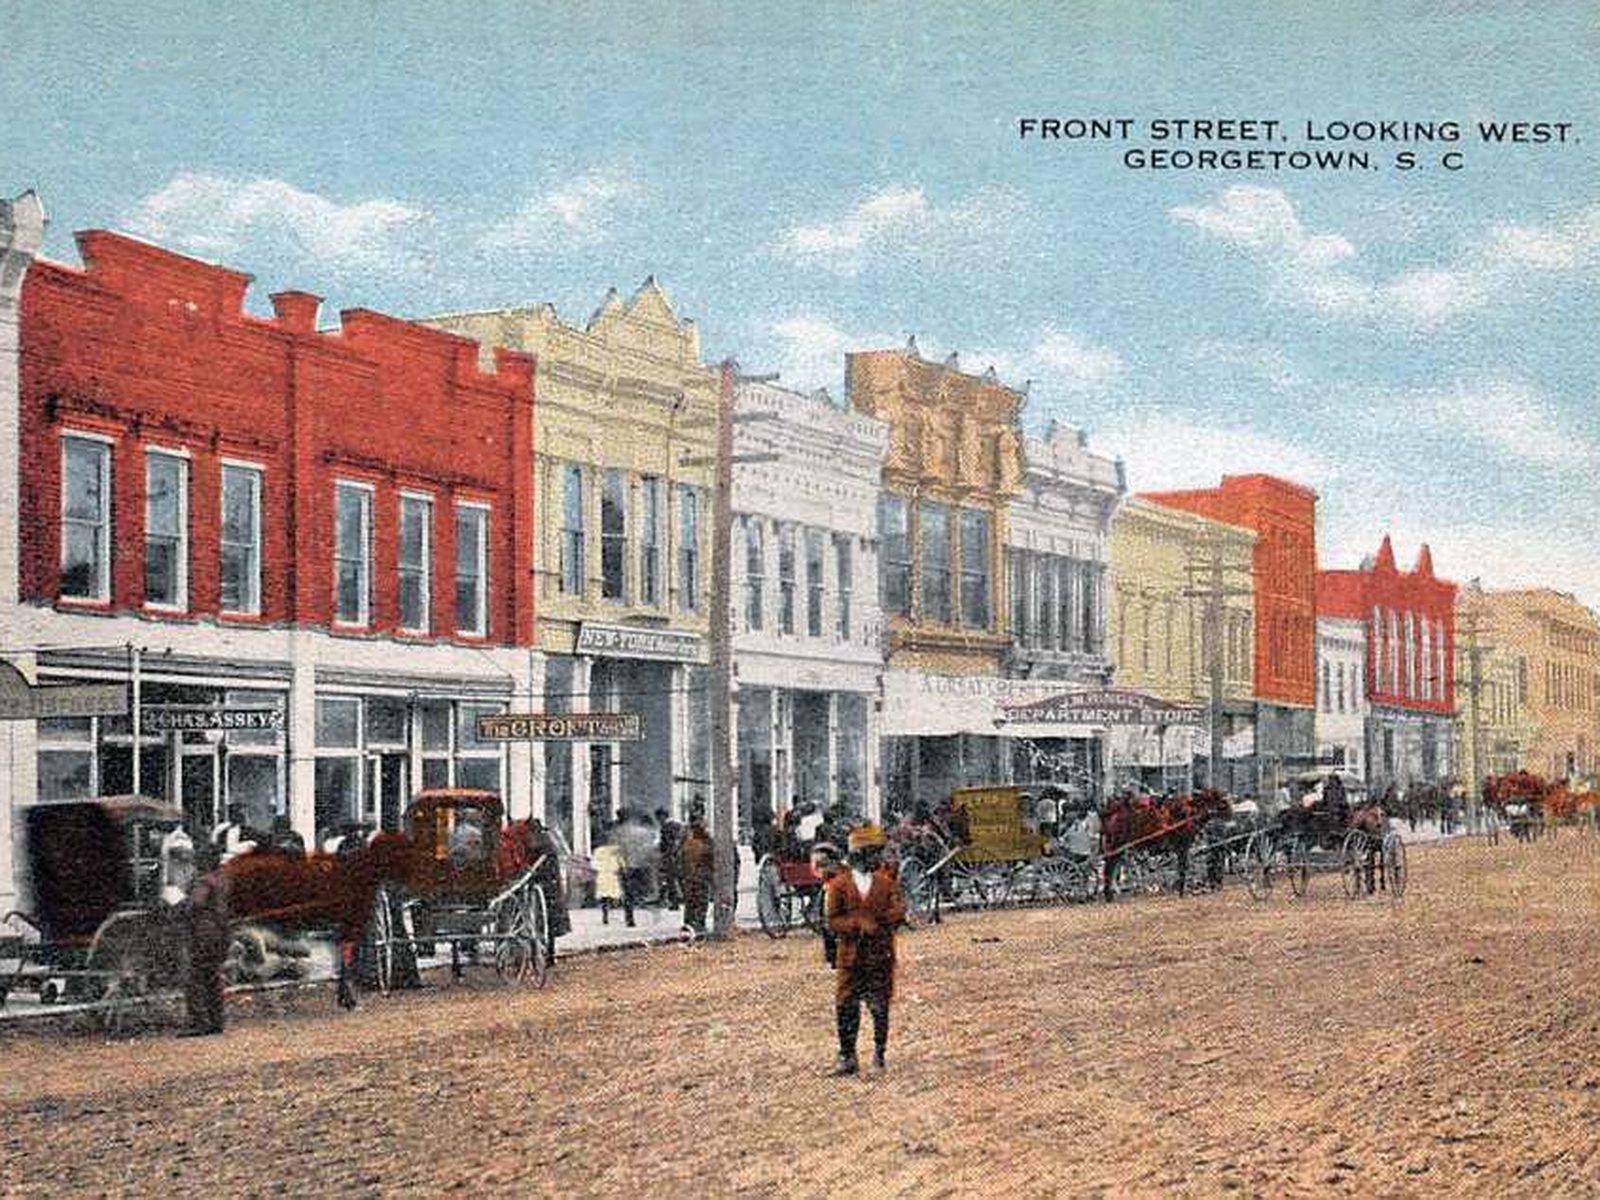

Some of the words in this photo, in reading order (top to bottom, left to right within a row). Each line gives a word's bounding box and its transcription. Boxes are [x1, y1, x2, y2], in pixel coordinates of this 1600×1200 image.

[210, 710, 271, 728] ASSEY
[1008, 706, 1132, 722] DEPARTMENT
[1140, 708, 1201, 723] STORE
